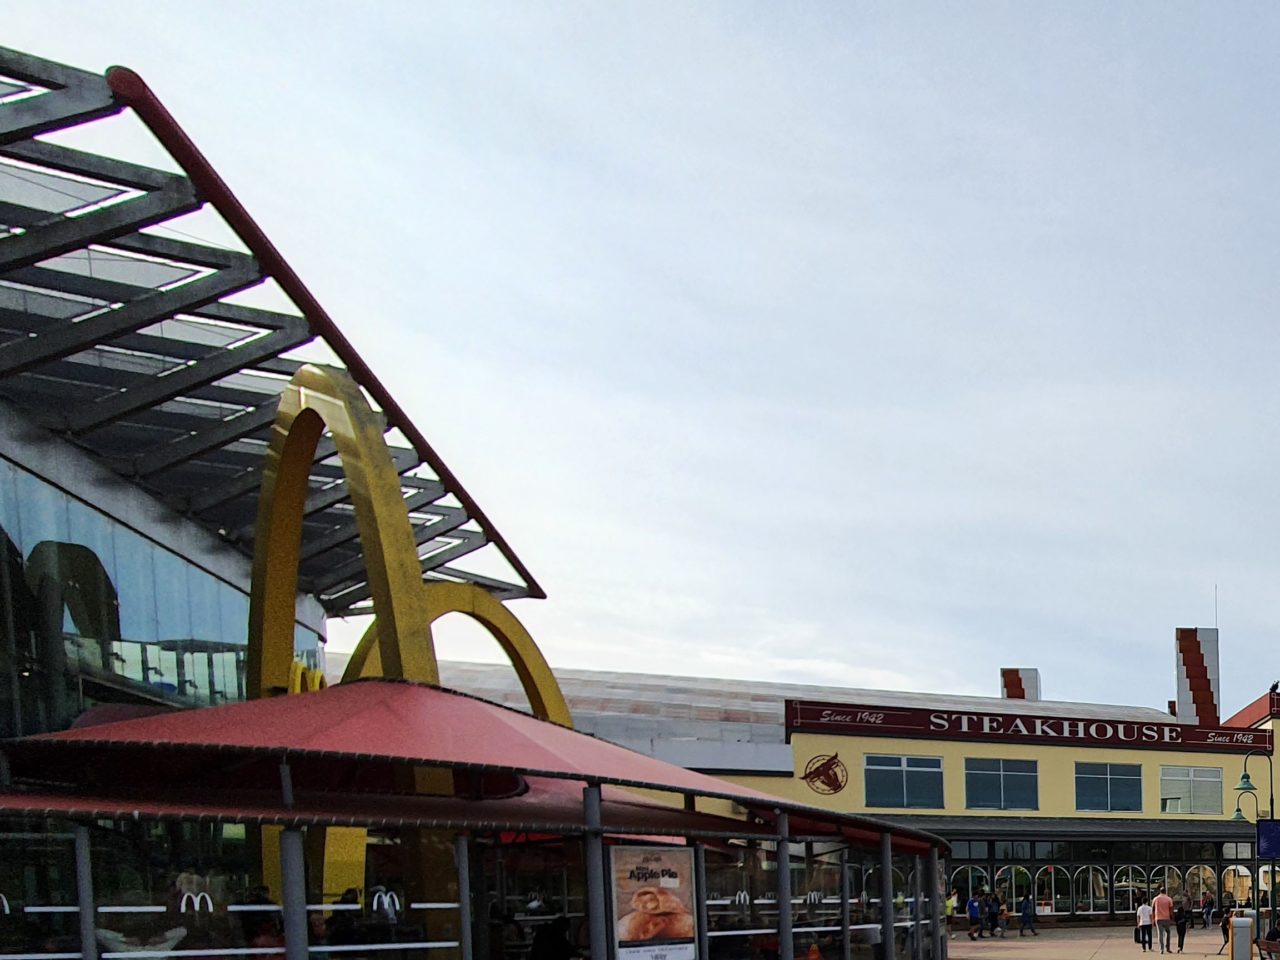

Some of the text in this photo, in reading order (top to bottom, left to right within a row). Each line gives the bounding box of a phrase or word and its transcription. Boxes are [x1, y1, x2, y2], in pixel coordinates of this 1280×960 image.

[819, 710, 884, 724] Since 1942
[929, 712, 1182, 743] STEAKHOUSE
[1206, 732, 1254, 744] Since 1942
[628, 868, 678, 882] Apple Pie
